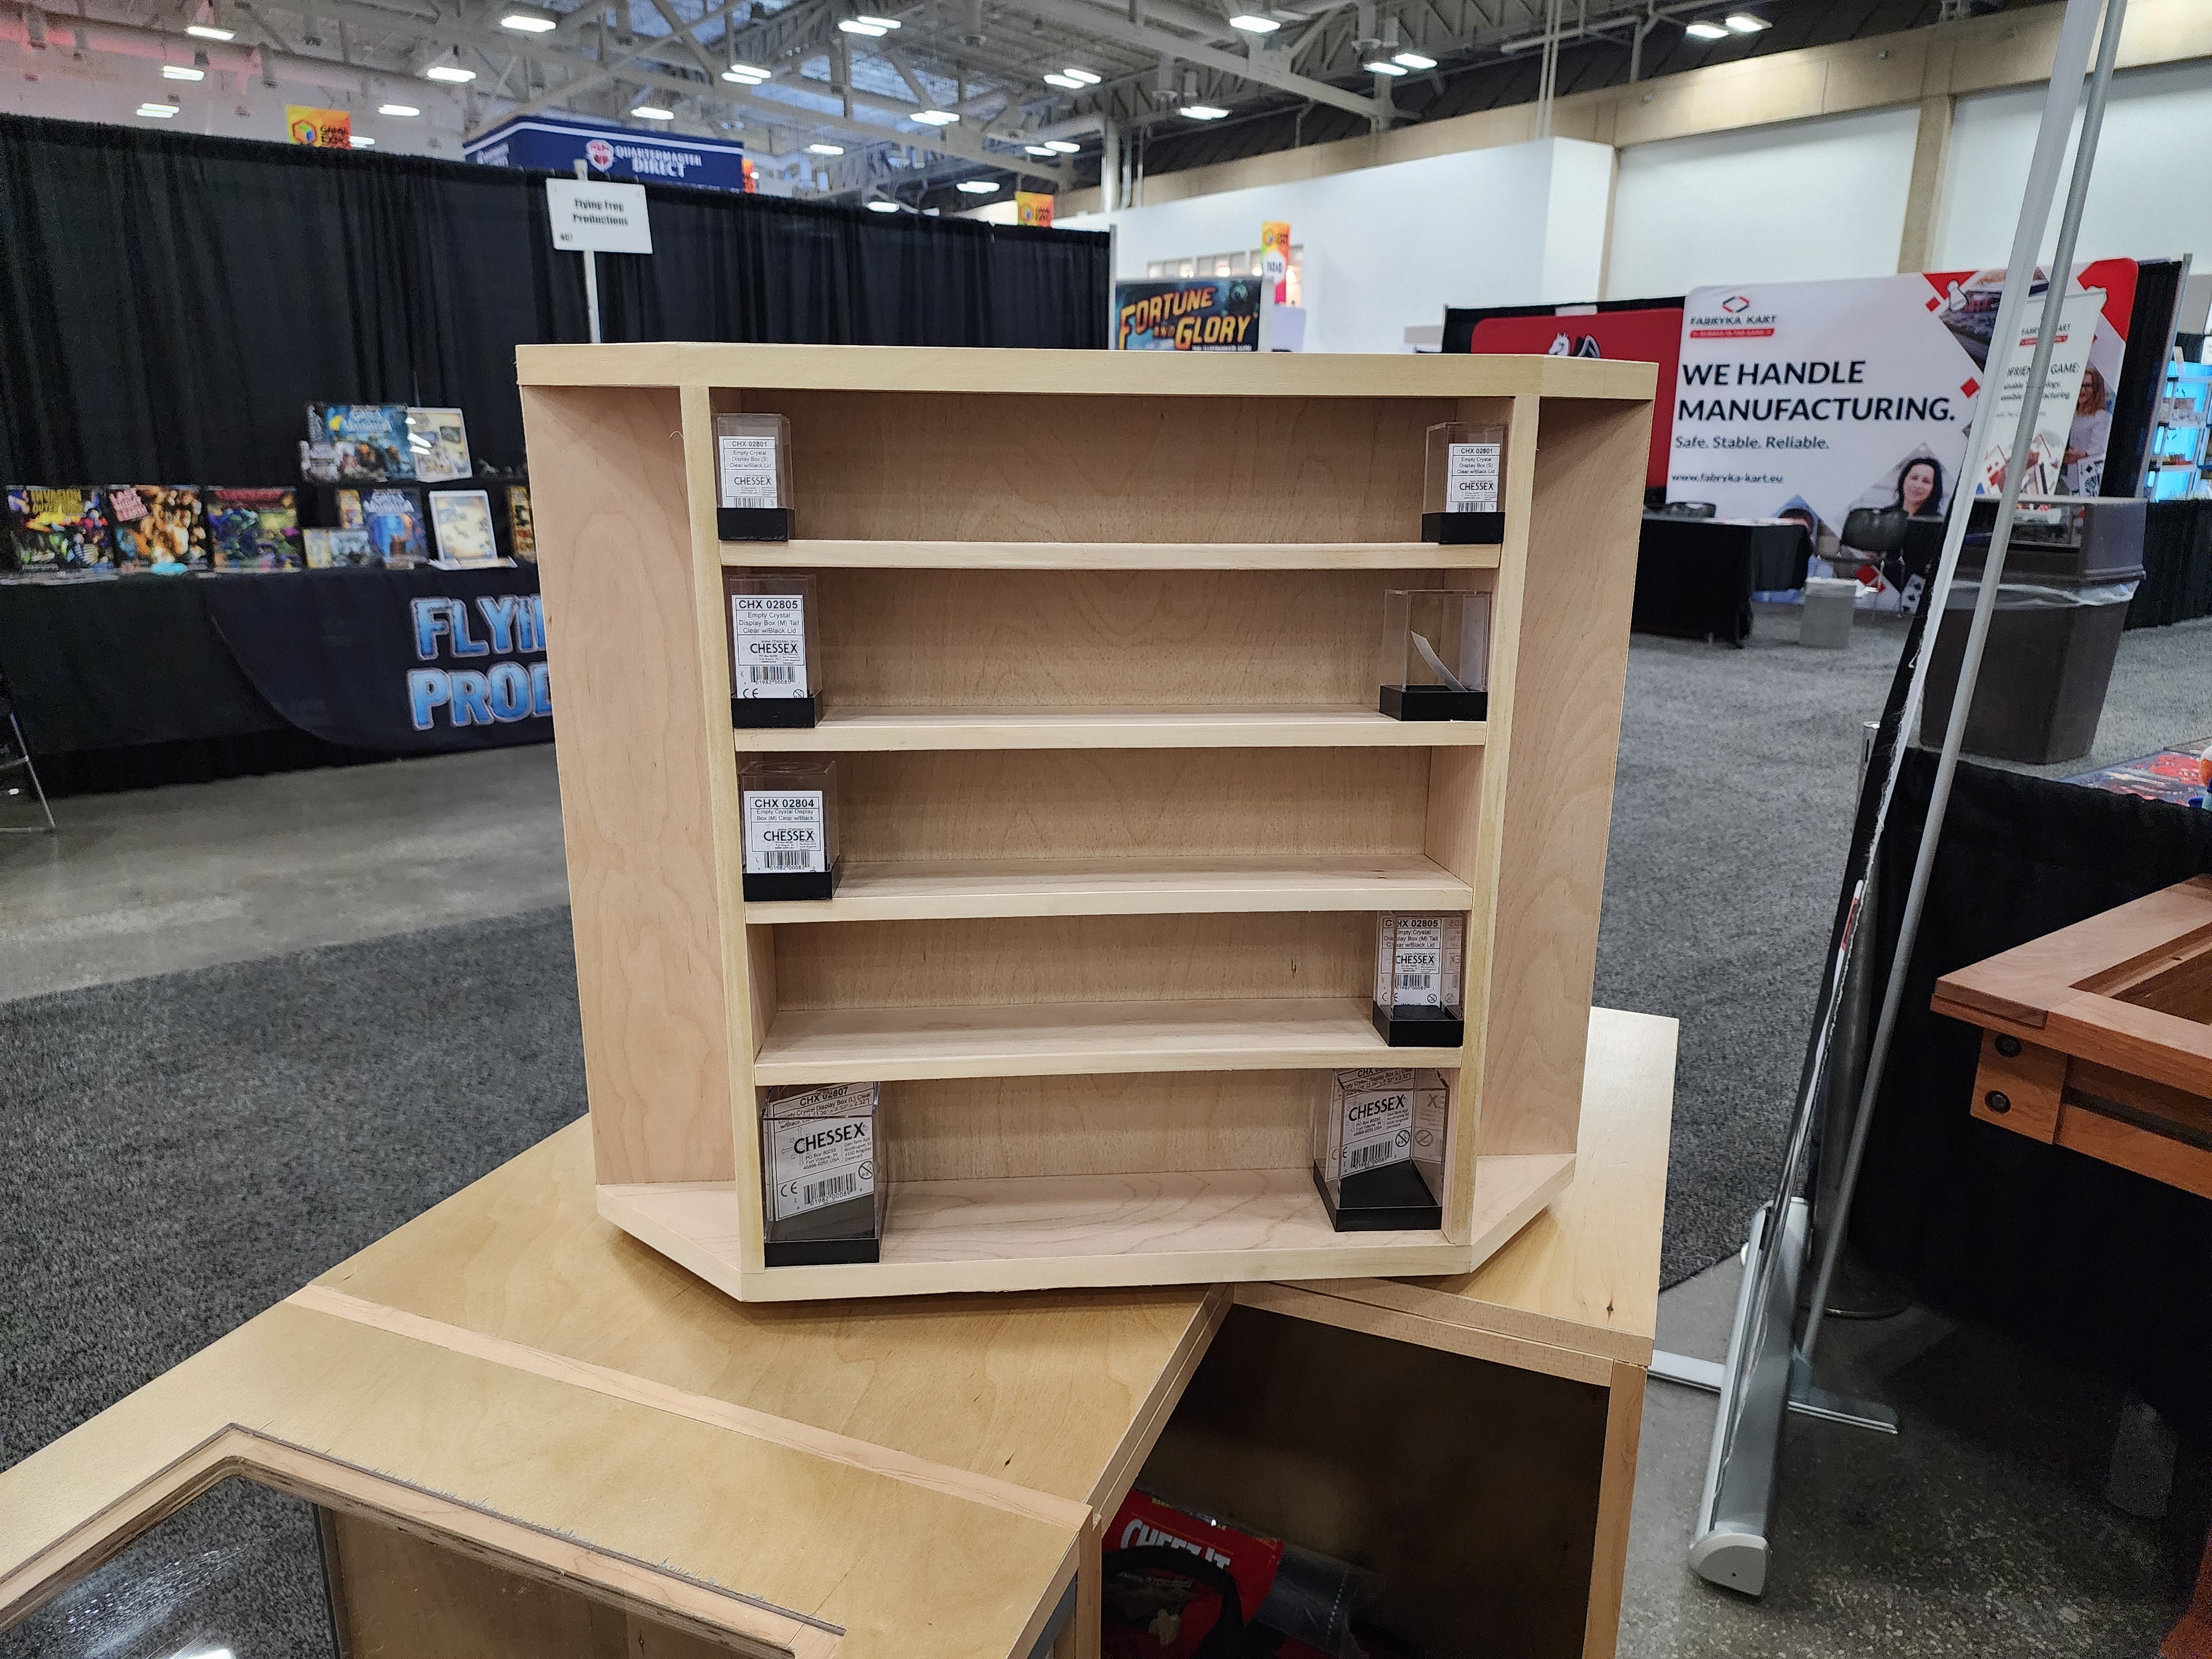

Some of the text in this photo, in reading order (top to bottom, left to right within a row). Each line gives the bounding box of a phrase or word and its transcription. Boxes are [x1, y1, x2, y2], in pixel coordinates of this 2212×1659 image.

[614, 145, 703, 167] QUARTERMASTER
[632, 157, 685, 178] DIRECT
[575, 198, 624, 212] Flying Frog
[573, 213, 629, 226] Productions
[1118, 286, 1217, 350] FORTUNE
[1690, 315, 1777, 325] FABRYKA KART
[1175, 314, 1251, 351] GLORY
[1682, 359, 1866, 386] WE HANDLE
[1677, 396, 1956, 421] MANUFACTURING.
[1675, 435, 1829, 449] Safe. Stable. Reliable.
[734, 477, 772, 486] CHESSEX
[1672, 473, 1783, 484] www.fabryka-kart.eu
[1459, 482, 1494, 491] CHESSEX
[739, 600, 798, 609] CHX 02805
[410, 594, 546, 661] FLYI
[750, 643, 798, 654] CHESSEX
[755, 799, 815, 808] CHX 02804
[763, 831, 815, 841] CHESSEX
[1385, 919, 1409, 927] CHX
[1396, 955, 1435, 964] CHESSEX
[1358, 1068, 1374, 1078] CHX
[800, 1087, 849, 1106] CHX 02807
[816, 1102, 836, 1111] Display
[857, 1092, 872, 1100] Clear
[1348, 1093, 1405, 1121] CHESSEX
[780, 1121, 801, 1129] w/Black
[794, 1121, 865, 1154] CHESSEX
[810, 1196, 829, 1206] 01982
[832, 1190, 851, 1199] 00089
